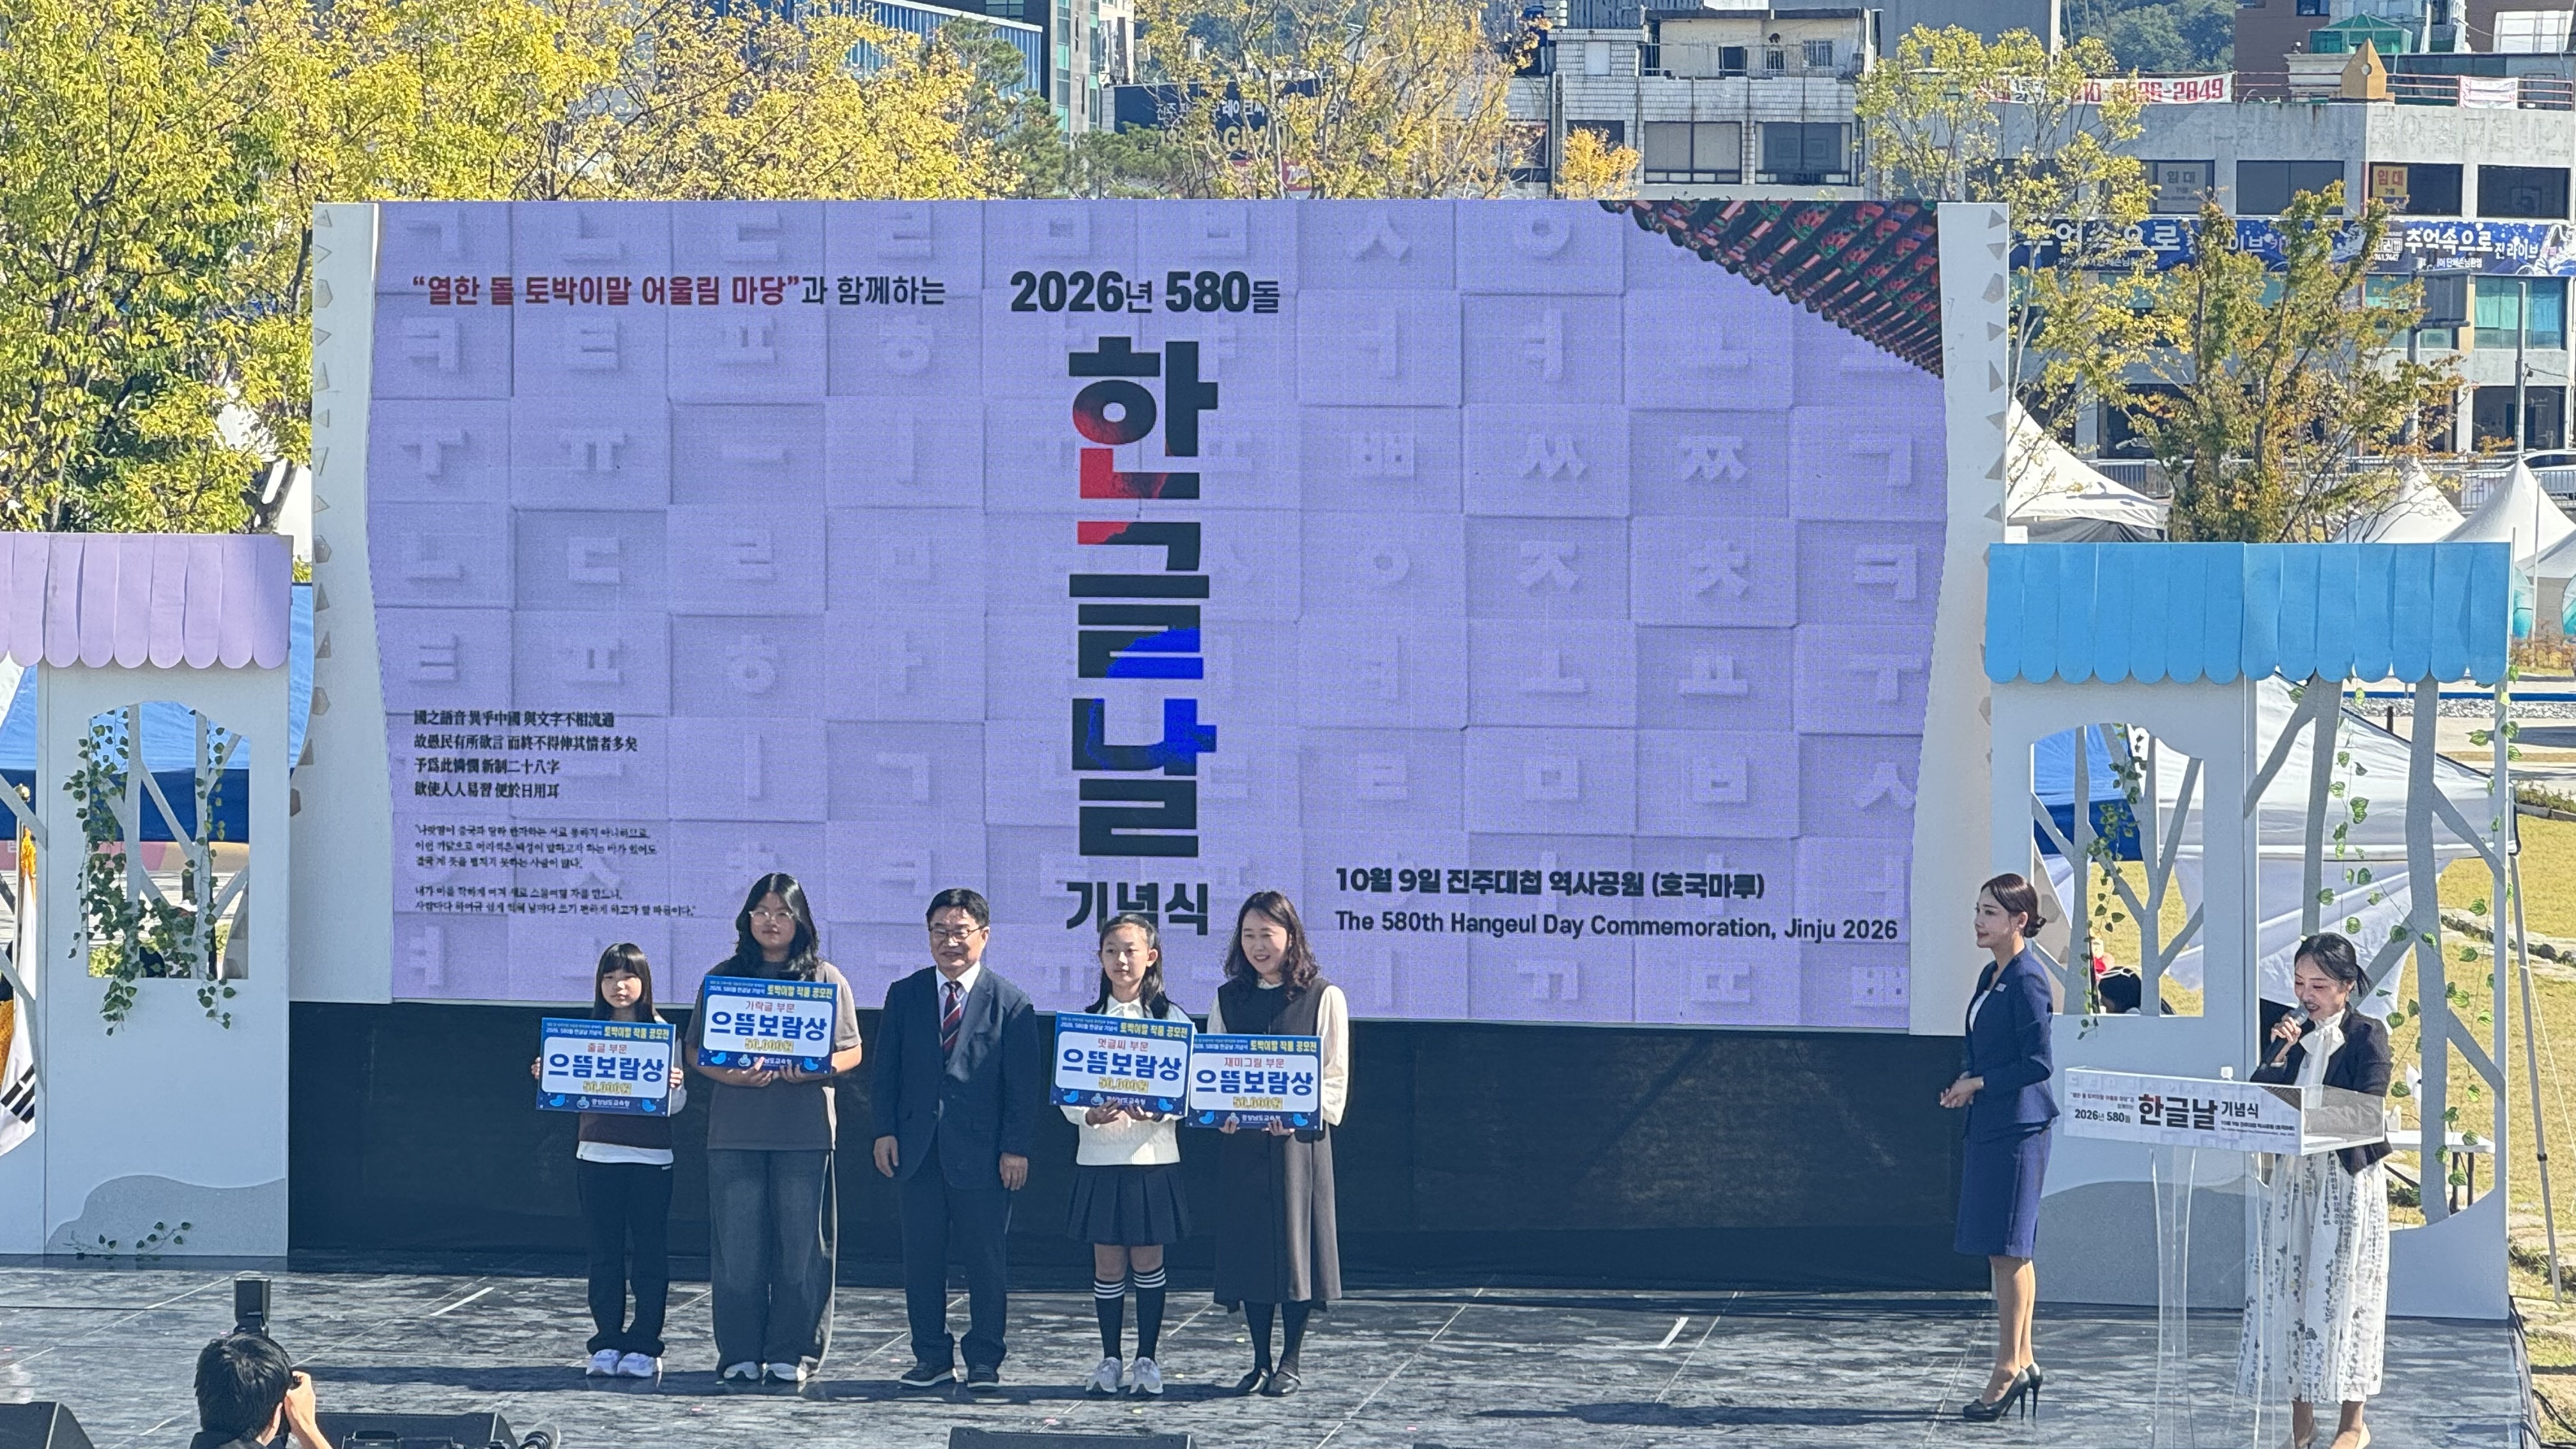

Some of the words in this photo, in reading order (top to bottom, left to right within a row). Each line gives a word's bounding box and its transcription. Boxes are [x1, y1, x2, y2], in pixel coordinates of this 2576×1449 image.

[2405, 228, 2492, 254] 추억속으로
[491, 276, 514, 305] 돌
[525, 276, 632, 306] 토박이말
[642, 276, 719, 306] 어울림
[837, 276, 946, 305] 함께하는
[1010, 271, 1153, 313] 2026년
[1165, 271, 1280, 313] 580돌
[1069, 337, 1218, 857] 한글날
[1336, 868, 1392, 893] 10월
[1399, 868, 1441, 894] 9일
[1447, 868, 1542, 895] 진주대첩
[1549, 870, 1644, 897] 역사공원
[1652, 871, 1765, 899] (호국마루)
[1066, 881, 1209, 936] 기념식
[1335, 910, 1374, 931] The
[1382, 911, 1444, 932] 580th
[1452, 912, 1536, 938] Hangeul
[1544, 914, 1584, 939] Day
[1591, 915, 1776, 940] Commemoration,
[1784, 917, 1836, 944] Jinju
[1843, 919, 1897, 939] 2026
[746, 1000, 773, 1012] 가락글
[776, 1002, 795, 1013] 부문
[710, 1011, 827, 1041] 으뜸보람상
[610, 1044, 627, 1054] 부문
[745, 1038, 794, 1053] 50,000원
[1098, 1038, 1126, 1050] 멋글씨
[1130, 1041, 1149, 1052] 부문
[548, 1054, 664, 1082] 으뜸보람상
[1062, 1048, 1182, 1081] 으뜸보람상
[1266, 1058, 1284, 1068] 부문
[1196, 1070, 1314, 1096] 으뜸보람상
[2074, 1108, 2104, 1122] 2026년
[2138, 1094, 2218, 1131] 한글날
[2221, 1101, 2258, 1119] 기념식
